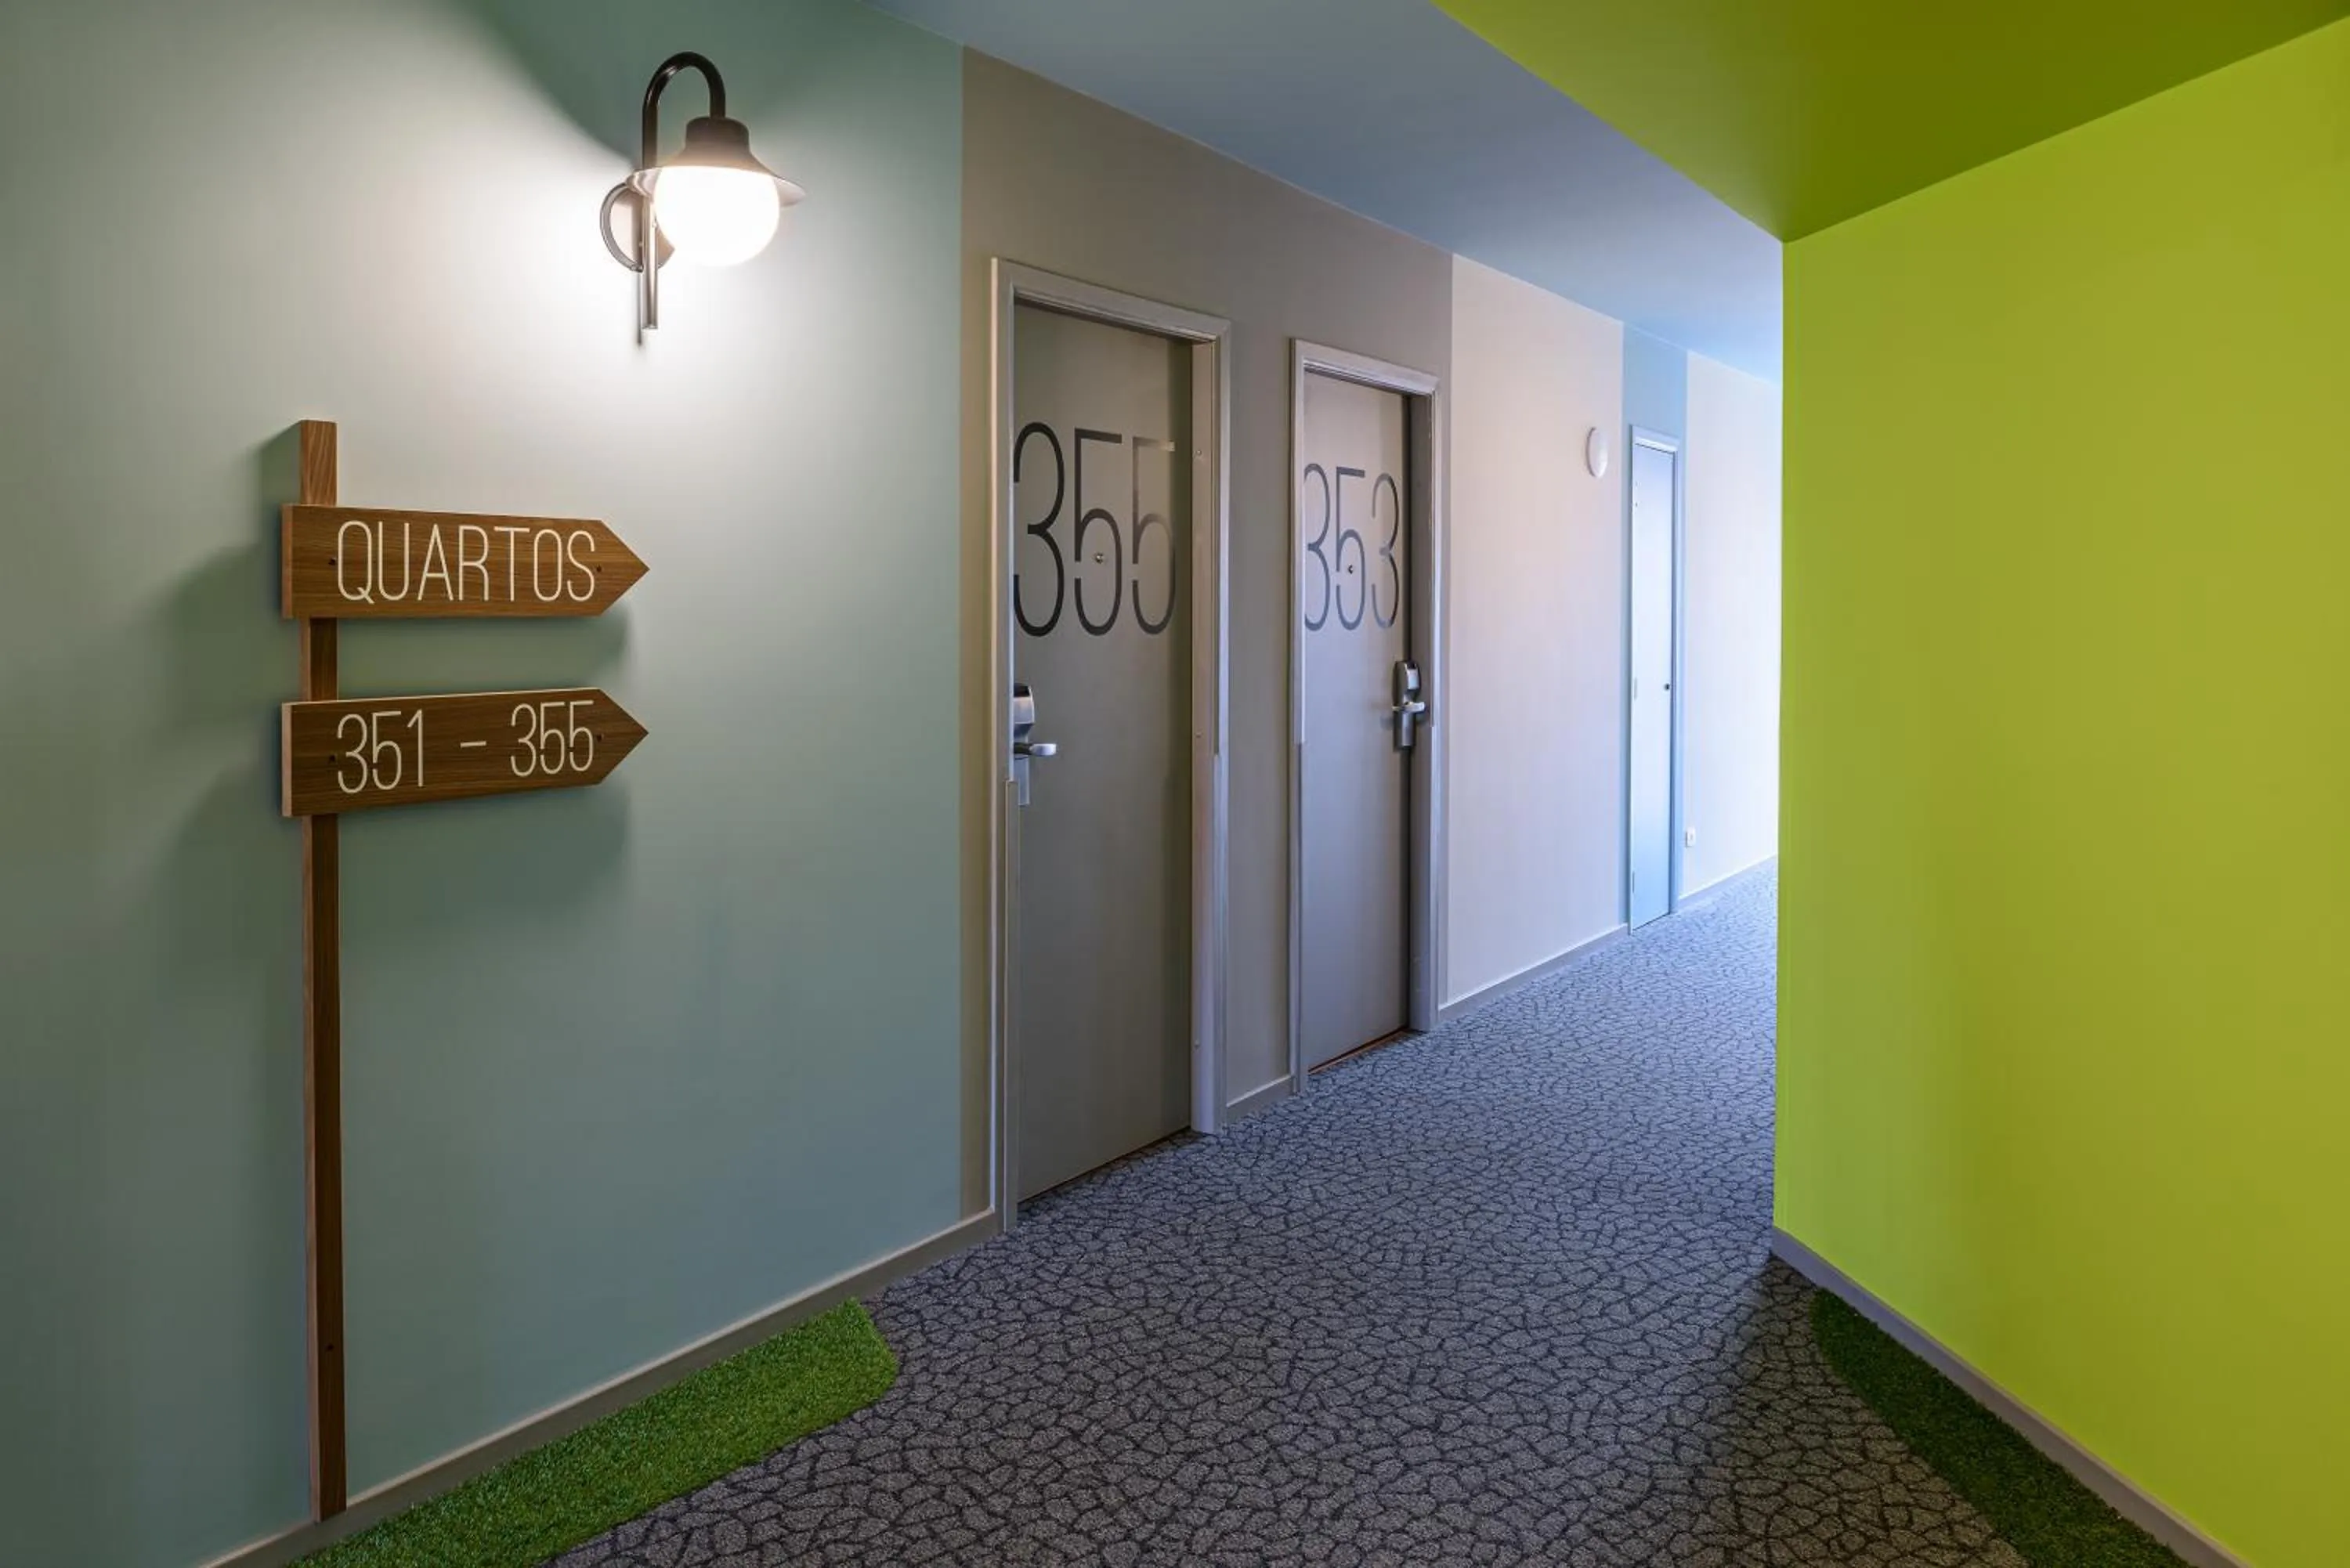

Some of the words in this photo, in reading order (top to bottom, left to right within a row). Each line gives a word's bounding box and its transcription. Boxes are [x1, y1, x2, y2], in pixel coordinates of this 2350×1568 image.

[337, 520, 595, 605] QUARTOS
[1014, 421, 1176, 637] 355
[1303, 463, 1400, 631] 353
[337, 709, 425, 793] 351
[510, 700, 595, 777] 355
